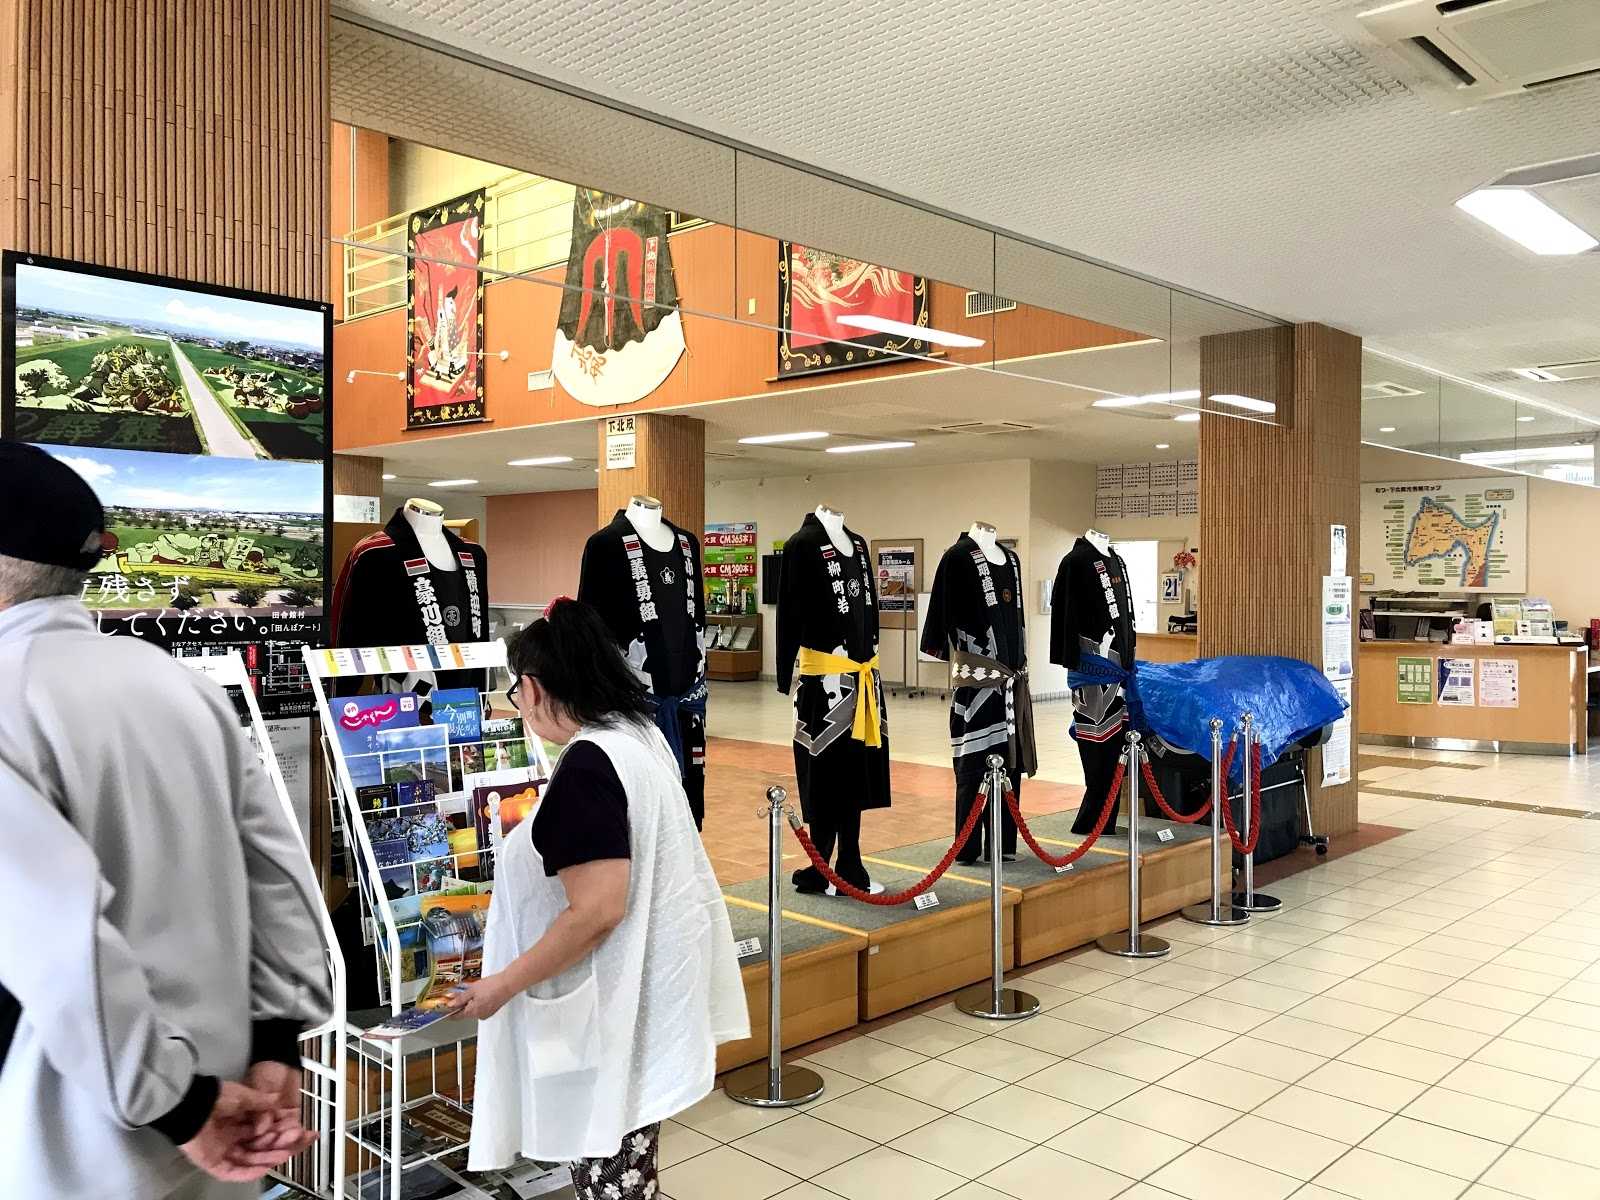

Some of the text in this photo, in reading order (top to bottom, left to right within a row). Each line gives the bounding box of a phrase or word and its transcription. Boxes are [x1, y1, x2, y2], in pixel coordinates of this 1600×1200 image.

[630, 558, 658, 622] 義勇組
[685, 557, 695, 618] 小川町
[827, 560, 849, 614] 柳町若
[1165, 578, 1178, 597] 21
[96, 608, 268, 637] してください。
[271, 623, 321, 632] 「田んぼアート」
[272, 611, 305, 619] 田舎館村
[413, 576, 448, 645] 豪川組
